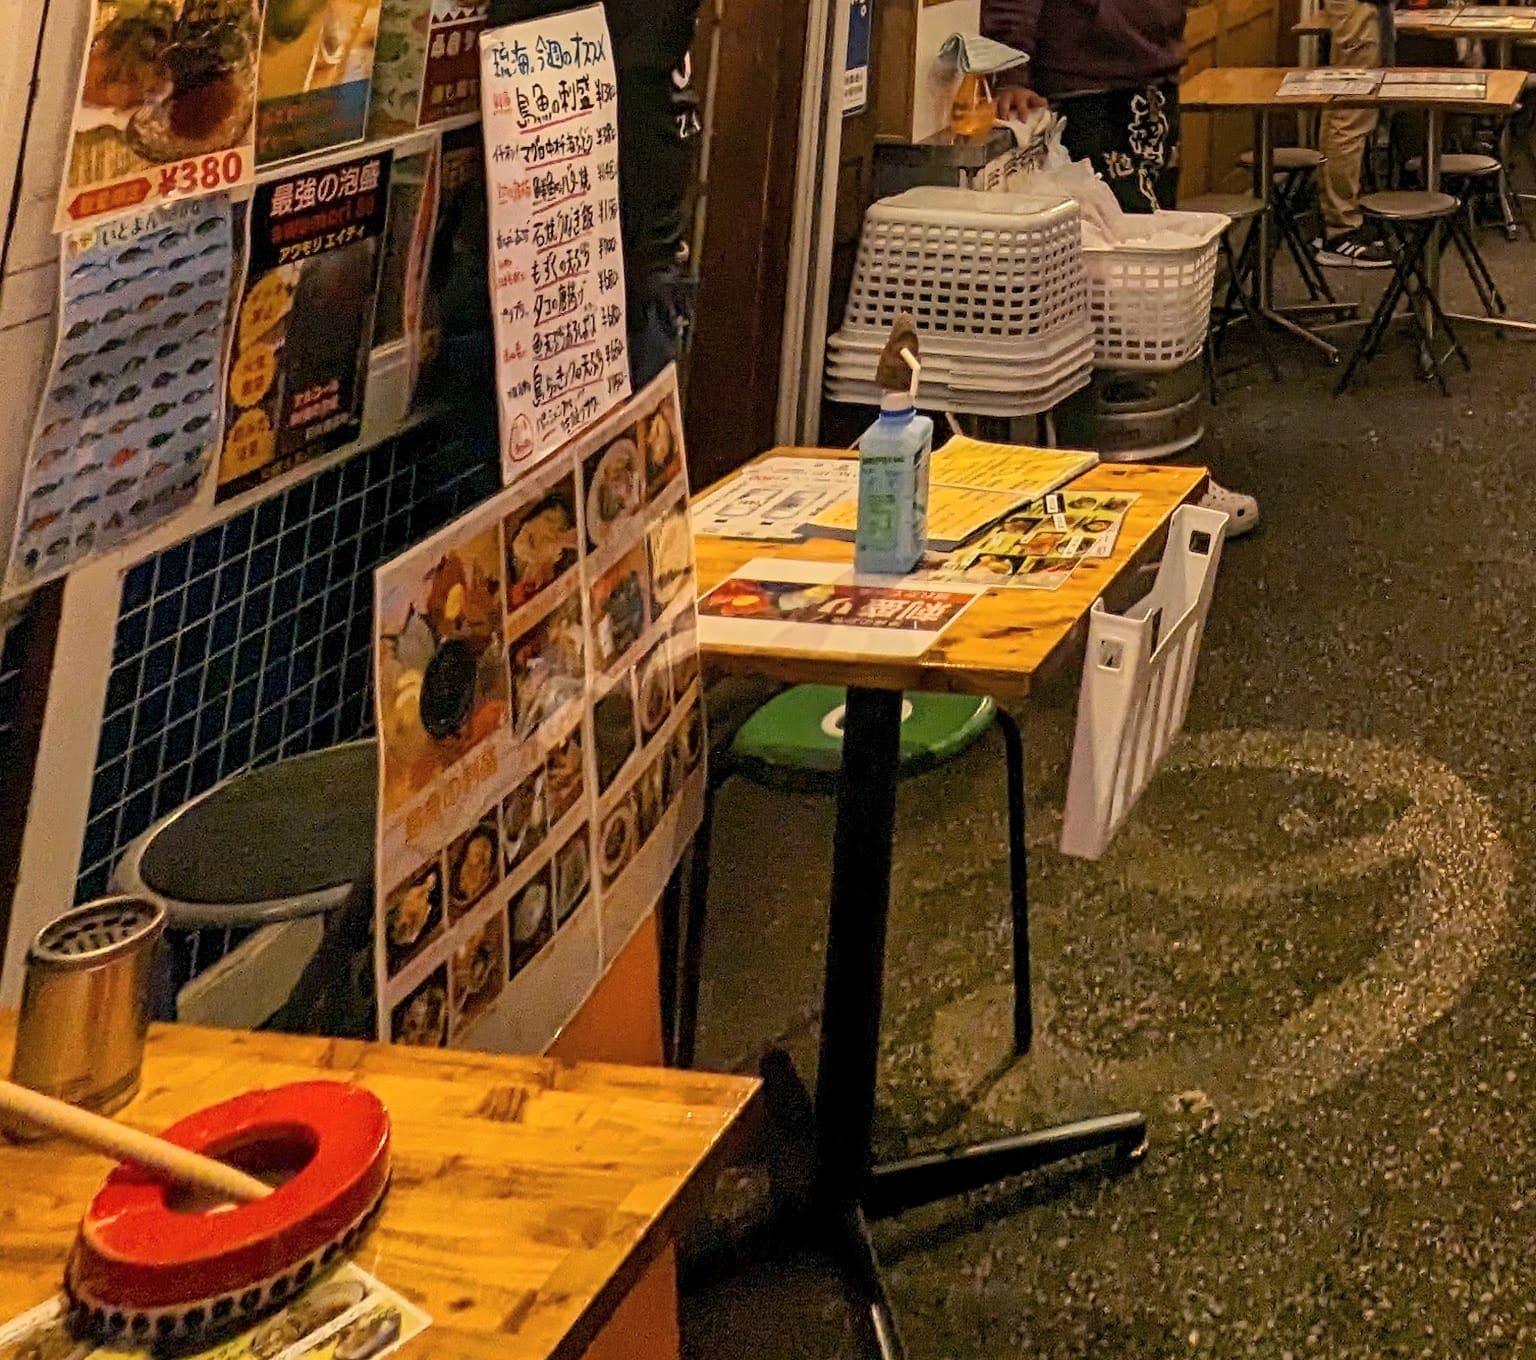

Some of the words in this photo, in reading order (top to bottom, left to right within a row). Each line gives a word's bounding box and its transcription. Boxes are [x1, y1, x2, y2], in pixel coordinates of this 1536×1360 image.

[269, 159, 381, 218] 最強の泡盛
